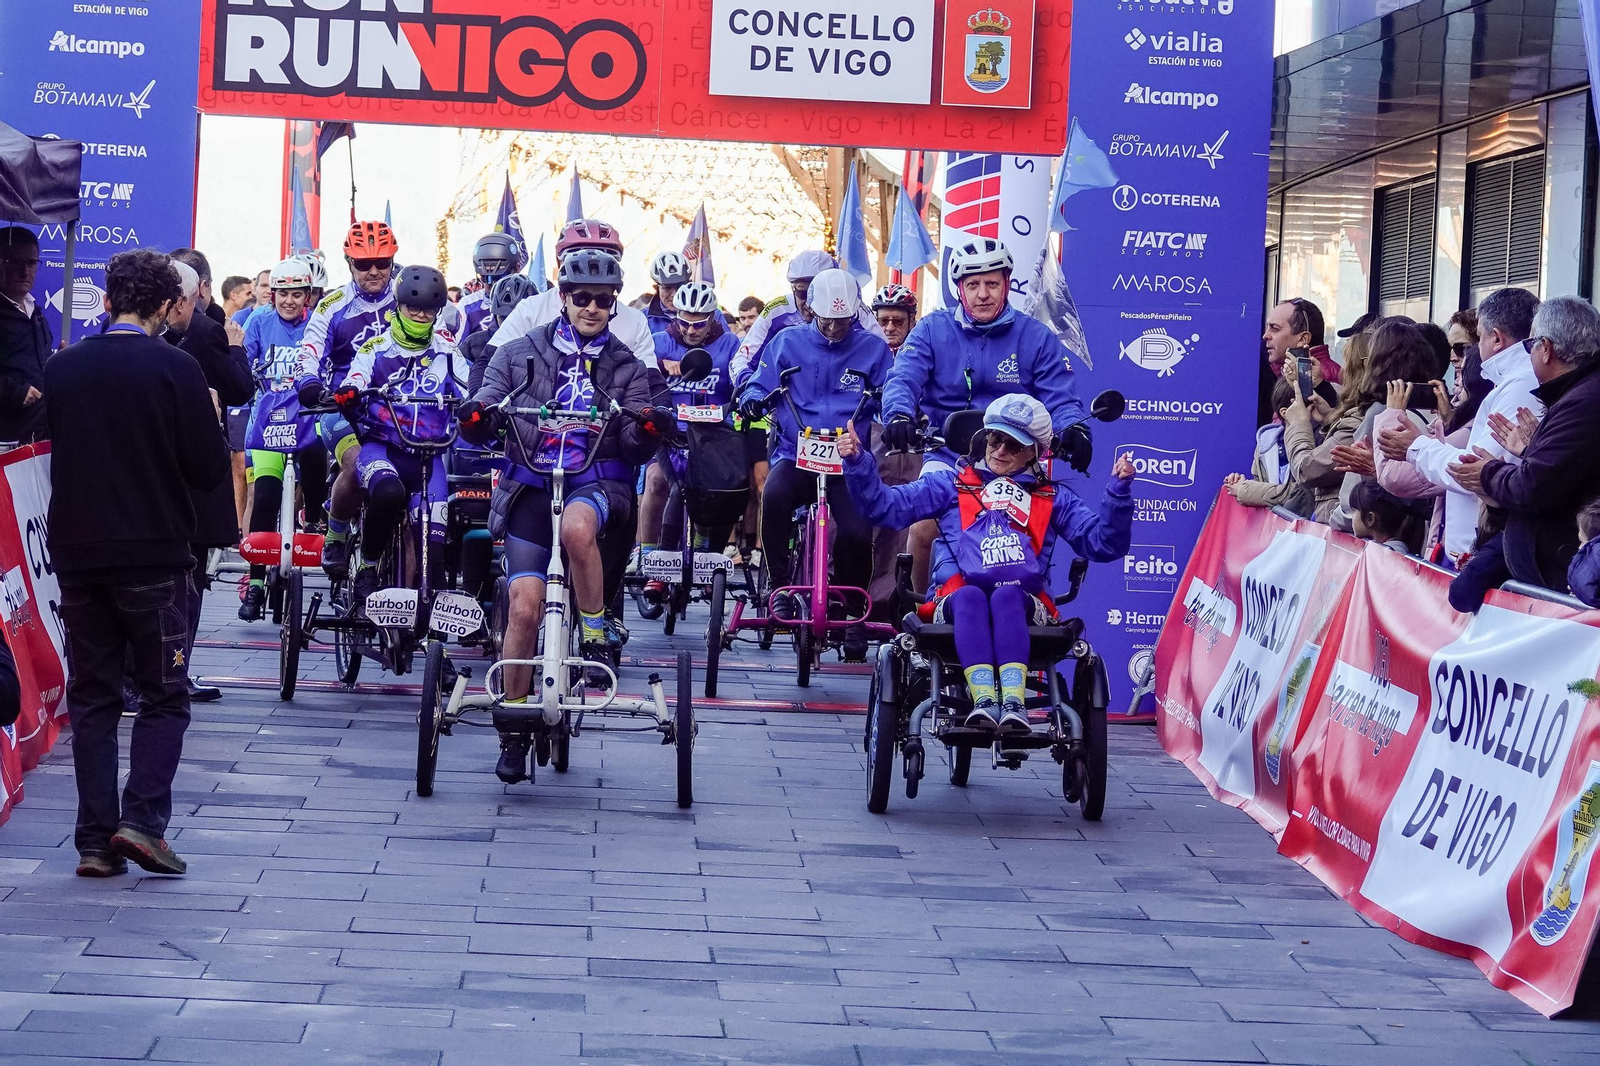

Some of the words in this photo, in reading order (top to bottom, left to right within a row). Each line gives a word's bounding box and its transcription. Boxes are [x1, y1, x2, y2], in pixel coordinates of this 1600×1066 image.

[73, 4, 112, 15] ESTACIÓN
[115, 6, 126, 15] DE
[128, 7, 149, 16] VIGO
[728, 8, 915, 43] CONCELLO
[49, 30, 145, 58] Alcampo
[1149, 30, 1223, 53] vialia
[750, 45, 794, 73] DE
[807, 47, 892, 77] VIGO
[1148, 56, 1186, 67] ESTACIÓN
[1189, 58, 1200, 67] DE
[1202, 58, 1222, 68] VIGO
[37, 82, 65, 91] GRUPO
[34, 90, 123, 108] BOTAMAVI
[1123, 82, 1219, 110] Alcampo
[800, 108, 862, 140] Vigo
[943, 116, 973, 140] La
[1112, 133, 1141, 142] GRUPO
[81, 142, 148, 158] OTERENA
[1109, 141, 1197, 158] BOTAMAVI
[1141, 192, 1221, 208] COTERENA
[1122, 230, 1185, 250] FIATC
[1121, 248, 1204, 259] SEGUROS
[1112, 273, 1212, 295] MAROSA
[690, 409, 712, 417] 230
[810, 443, 835, 459] 227
[805, 460, 834, 473] Alcampo
[993, 482, 1024, 502] 383
[990, 501, 1017, 515] Alcapo
[980, 532, 1021, 550] CORRER
[644, 558, 682, 568] turbo10
[1123, 554, 1178, 576] Feito
[367, 598, 416, 611] turbo10
[434, 600, 482, 621] turbo10
[377, 616, 409, 624] VIGO
[437, 621, 467, 636] VIGO
[1401, 767, 1462, 851] DE
[1447, 783, 1518, 877] VIGO
